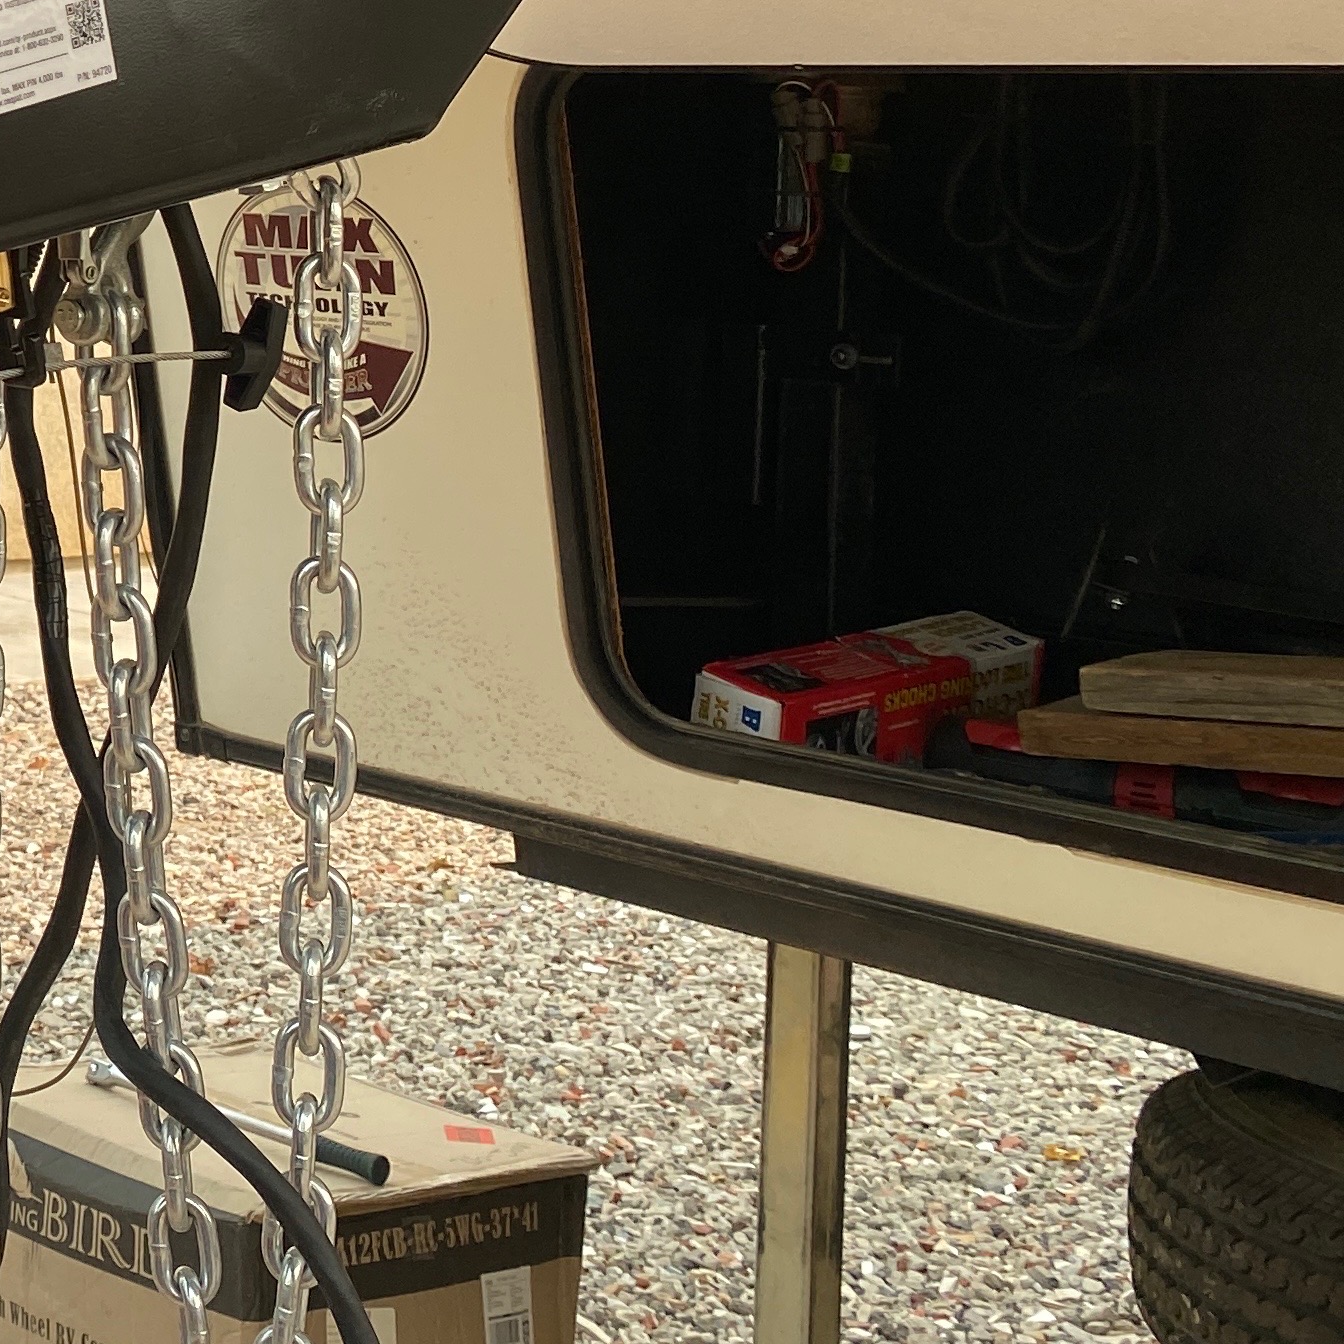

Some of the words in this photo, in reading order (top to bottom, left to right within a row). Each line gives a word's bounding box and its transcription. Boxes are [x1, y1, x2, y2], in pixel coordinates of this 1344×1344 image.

[234, 251, 396, 295] TUN
[884, 682, 937, 713] CHOCKS
[10, 1200, 39, 1232] ING
[10, 1301, 51, 1340] Wheel
